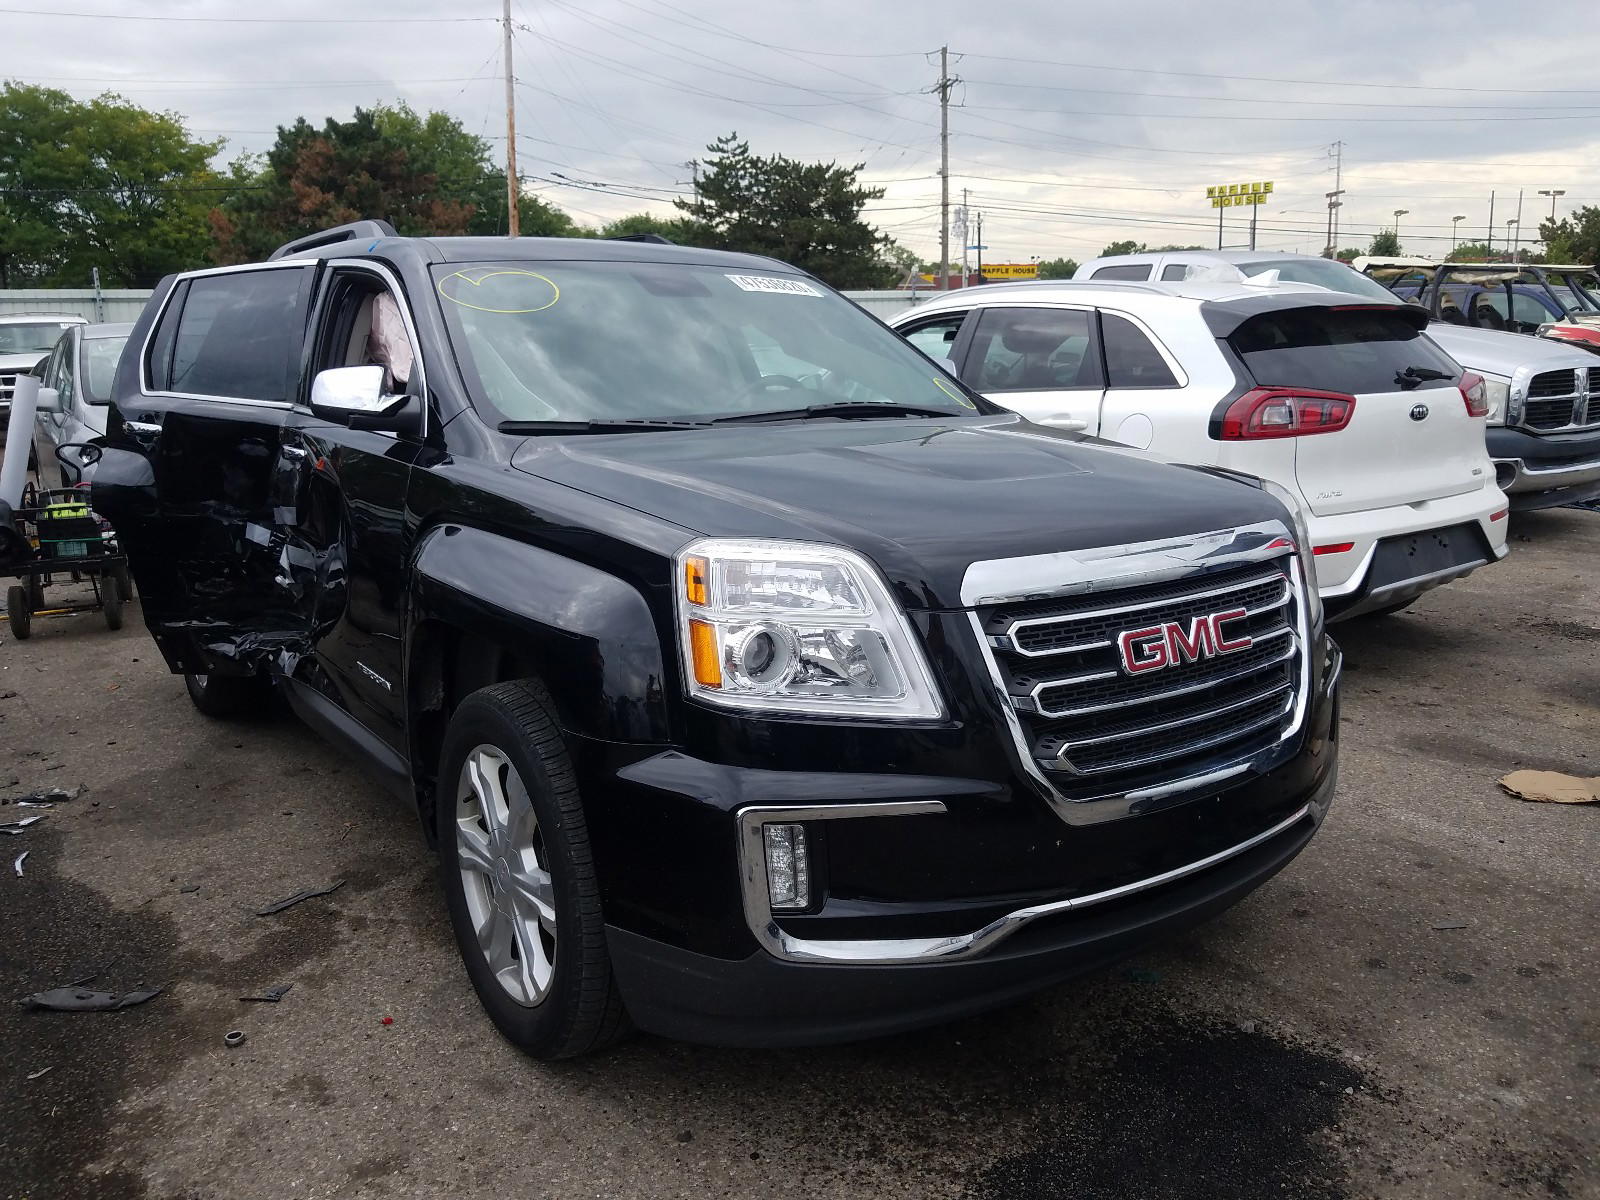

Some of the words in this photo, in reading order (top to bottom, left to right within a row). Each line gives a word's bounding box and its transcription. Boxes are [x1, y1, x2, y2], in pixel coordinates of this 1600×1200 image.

[1207, 182, 1272, 196] WAFFLE
[1213, 194, 1265, 207] HOUSE
[1117, 607, 1253, 676] GMC
